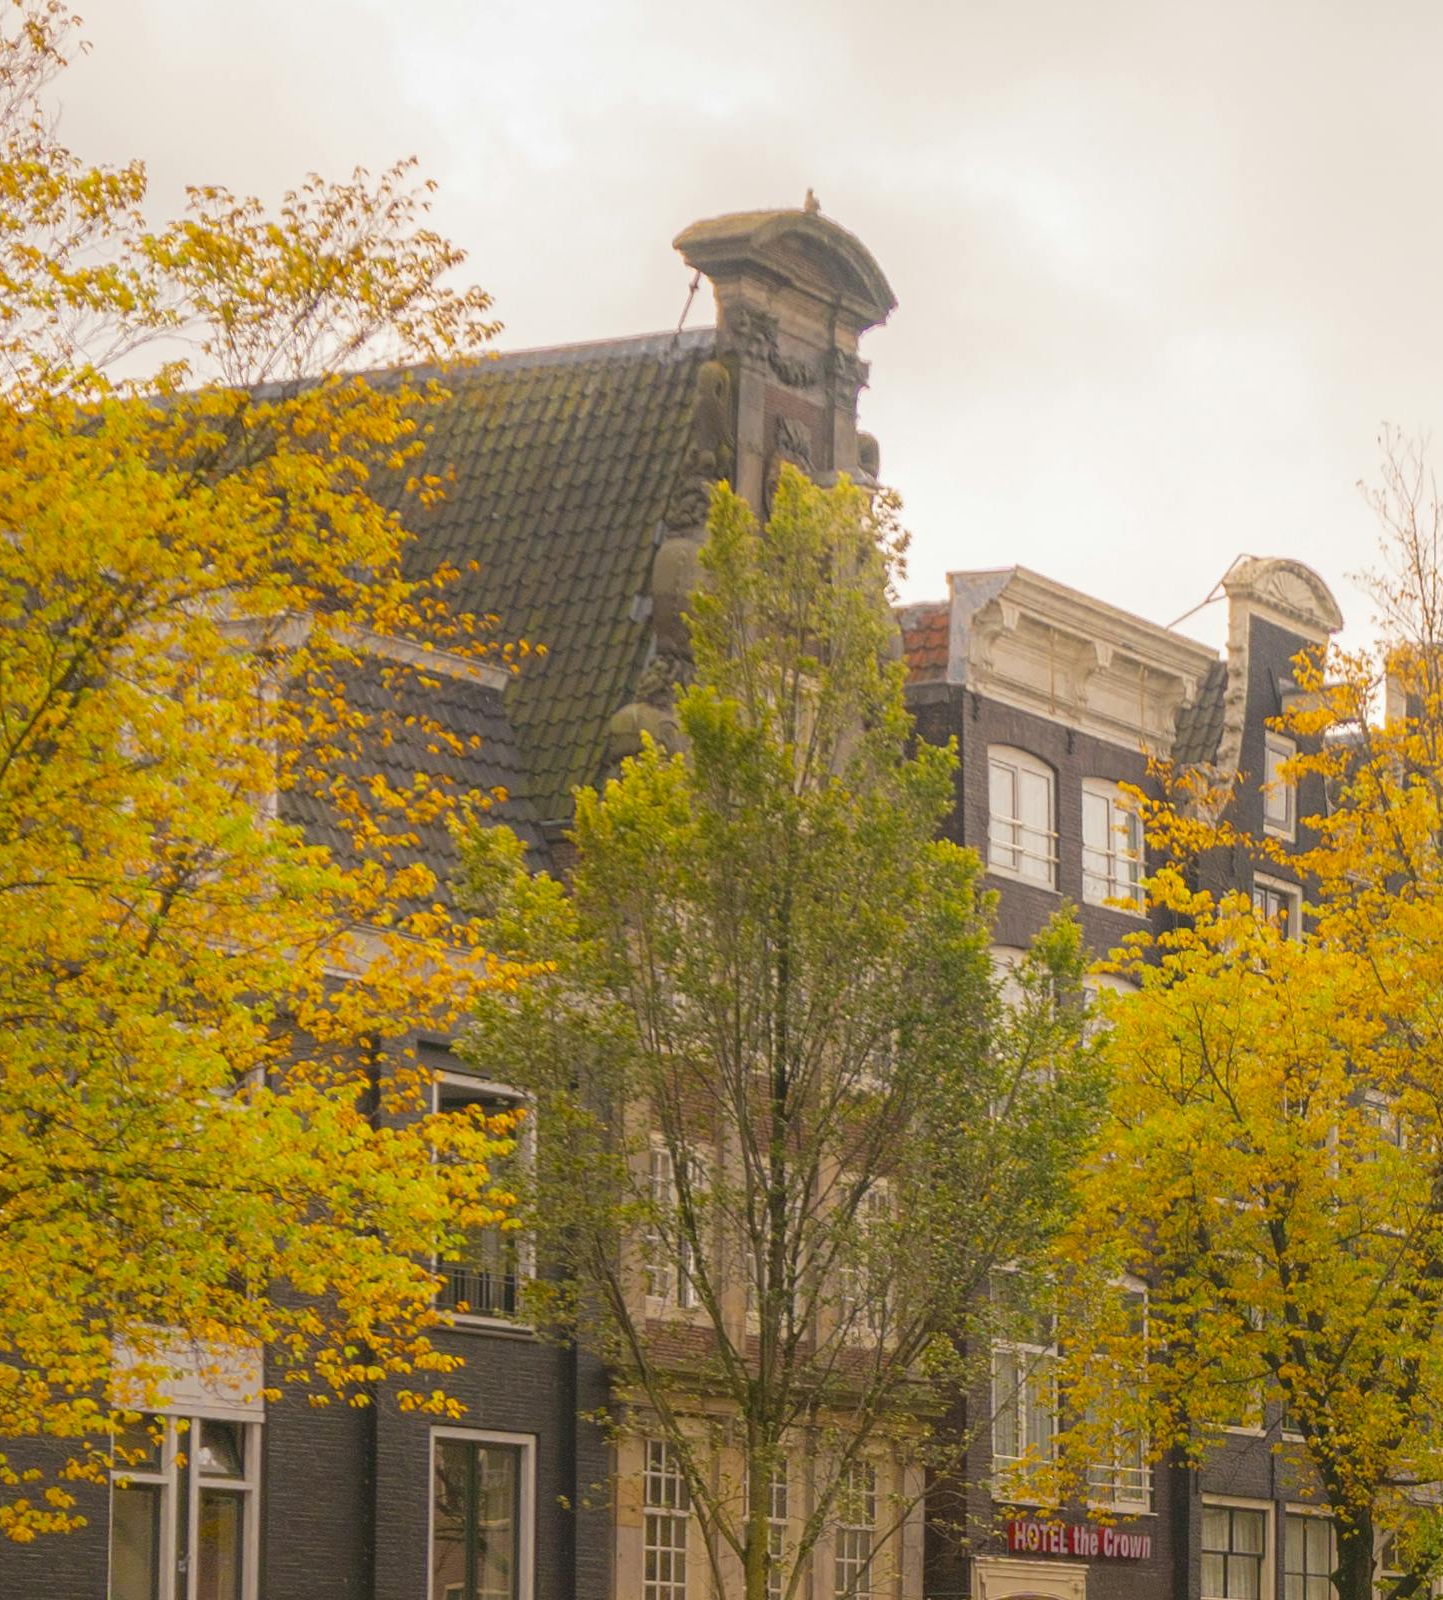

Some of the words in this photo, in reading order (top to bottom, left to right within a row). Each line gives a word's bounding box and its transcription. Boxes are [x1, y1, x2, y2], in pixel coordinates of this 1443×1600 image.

[1014, 1522, 1068, 1554] HOTEL
[1073, 1526, 1099, 1556] the
[1103, 1528, 1151, 1558] Crown
